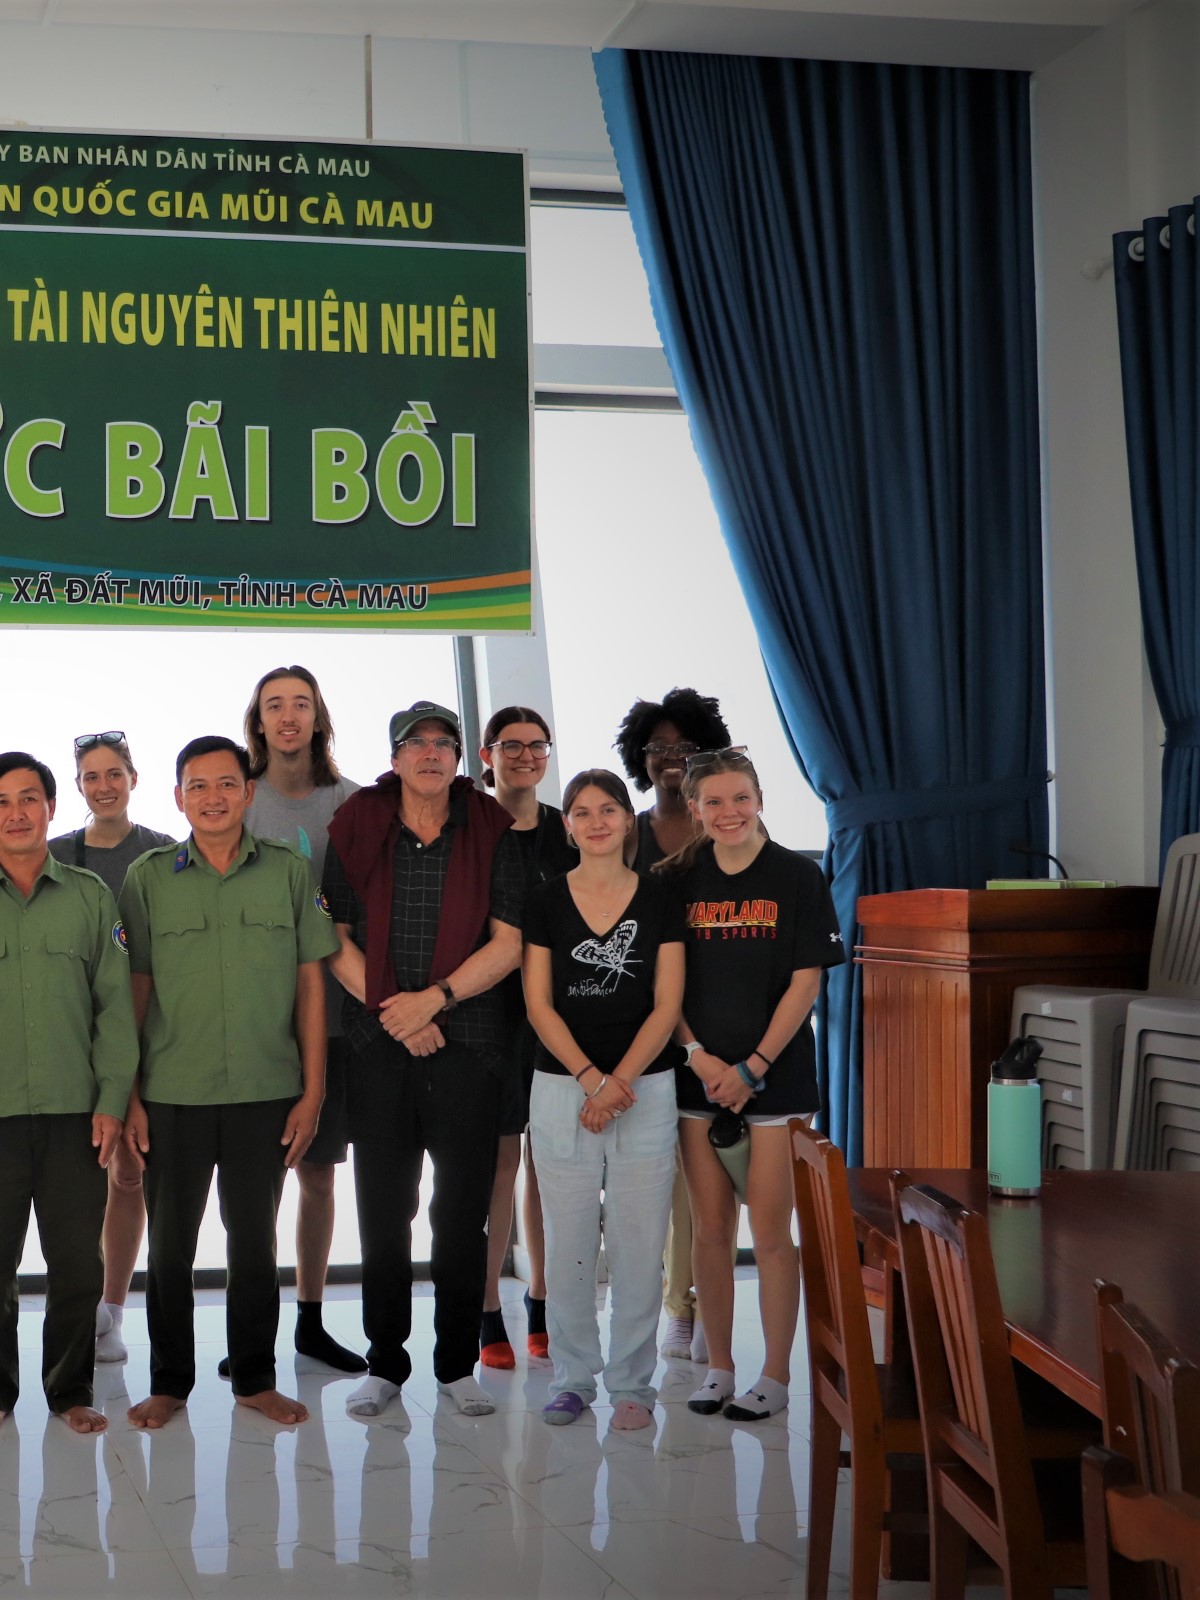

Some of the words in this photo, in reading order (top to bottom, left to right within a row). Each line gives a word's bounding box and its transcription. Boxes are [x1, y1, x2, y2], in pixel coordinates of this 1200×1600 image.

[19, 144, 69, 165] BAN
[77, 143, 149, 168] NHÂN
[156, 145, 208, 171] DÂN
[213, 147, 271, 173] TỈNH
[278, 149, 311, 176] CÀ
[317, 158, 371, 178] MAU
[32, 179, 136, 219] QUỐC
[147, 191, 210, 220] GIA
[221, 188, 288, 223] MŨI
[300, 191, 345, 226] CÀ
[356, 200, 433, 230] MAU
[7, 278, 68, 343] TÀI
[83, 284, 243, 349] NGUYÊN
[254, 289, 367, 353] THIÊN
[382, 295, 497, 358] NHIÊN
[105, 400, 270, 521] BÃI
[311, 401, 476, 527] BỒI
[12, 572, 56, 604] XÃ
[64, 571, 130, 605] ĐẤT
[138, 573, 211, 610] MŨI,
[219, 574, 296, 608] TỈNH
[305, 578, 349, 610] CÀ
[357, 583, 429, 611] MAU
[686, 900, 778, 923] MARYLAND
[722, 926, 778, 940] SPORTS
